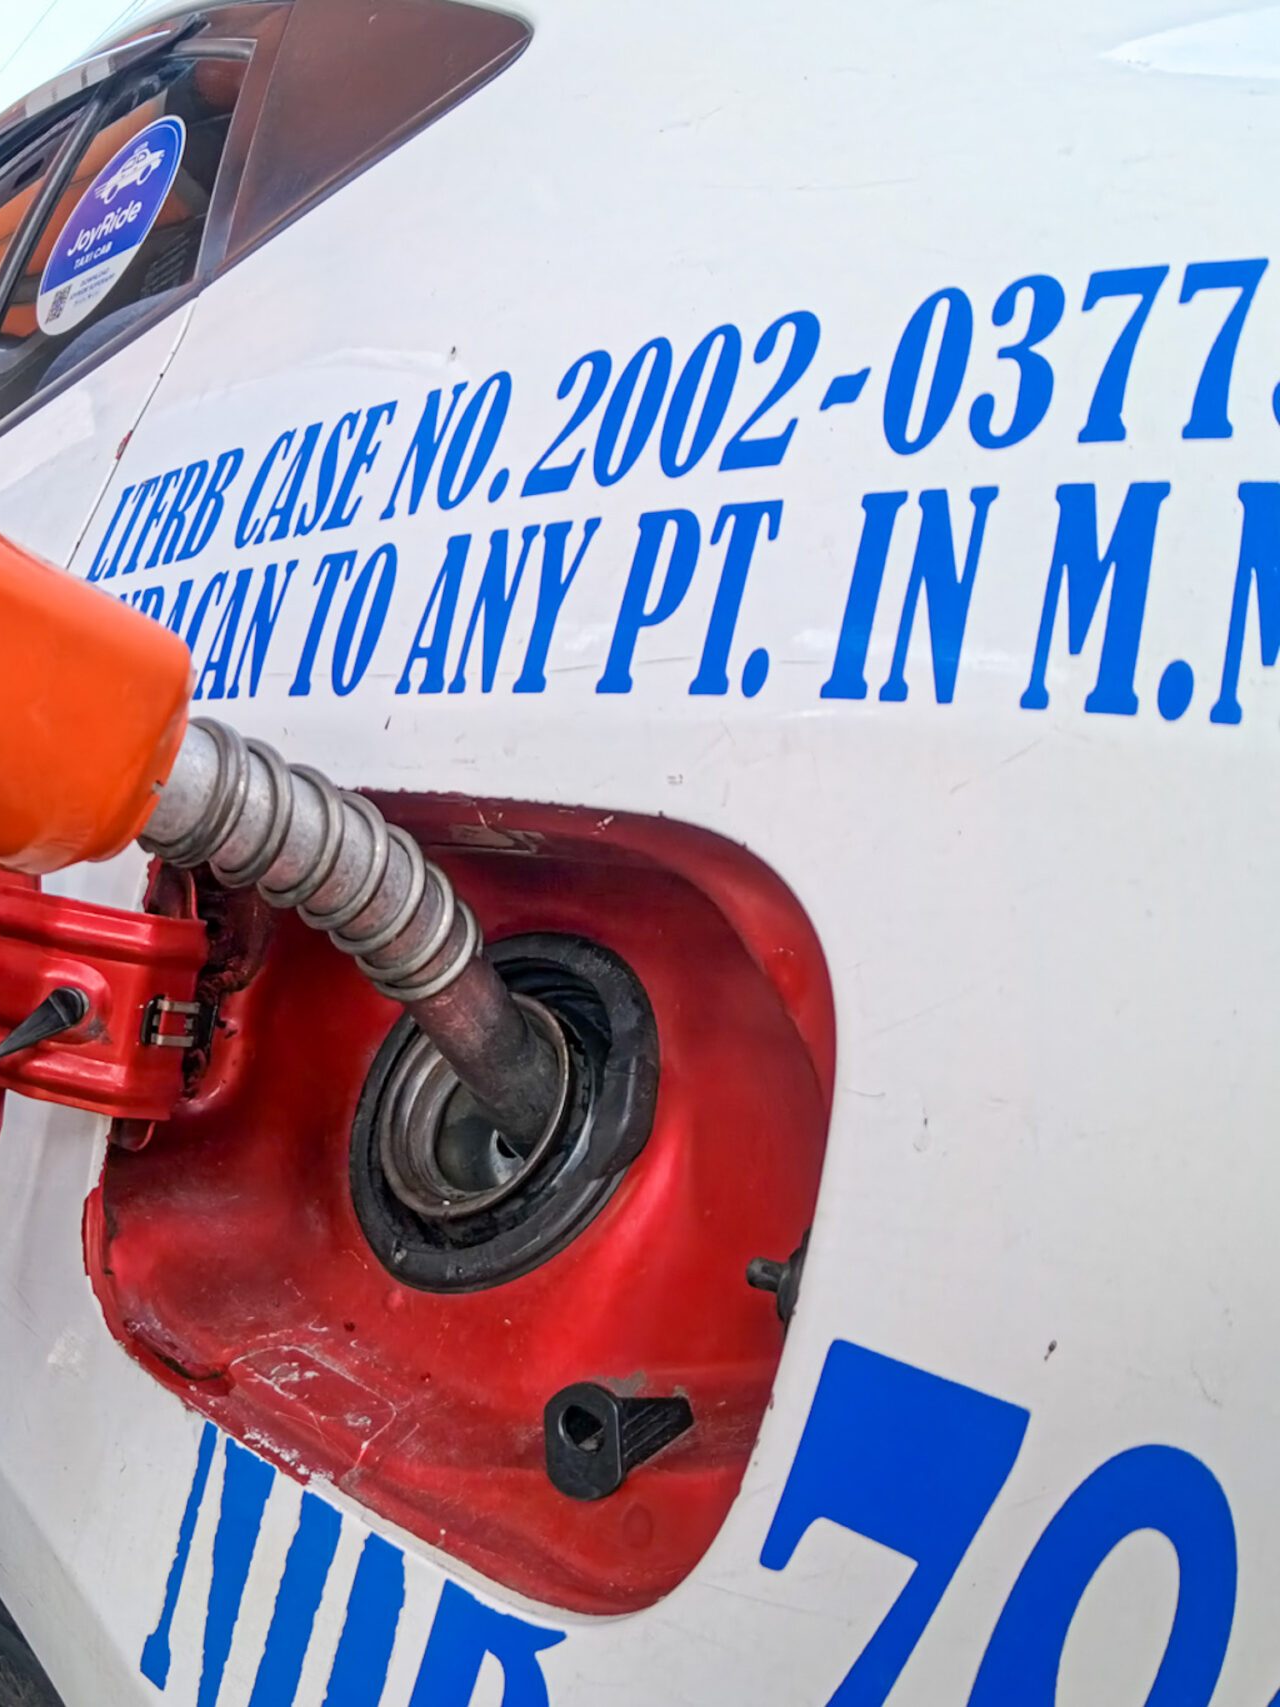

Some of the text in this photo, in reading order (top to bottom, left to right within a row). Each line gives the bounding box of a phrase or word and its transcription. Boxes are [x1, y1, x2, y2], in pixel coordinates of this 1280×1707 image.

[67, 200, 142, 257] JoyRide
[74, 241, 113, 270] TAXI CAB
[86, 258, 1280, 582] LTFRB CASE NO.2002-0377
[289, 544, 398, 697] TO
[396, 517, 602, 695] ANY
[596, 500, 784, 698] PT.
[820, 485, 999, 704] IN
[760, 1340, 1280, 1707] 70
